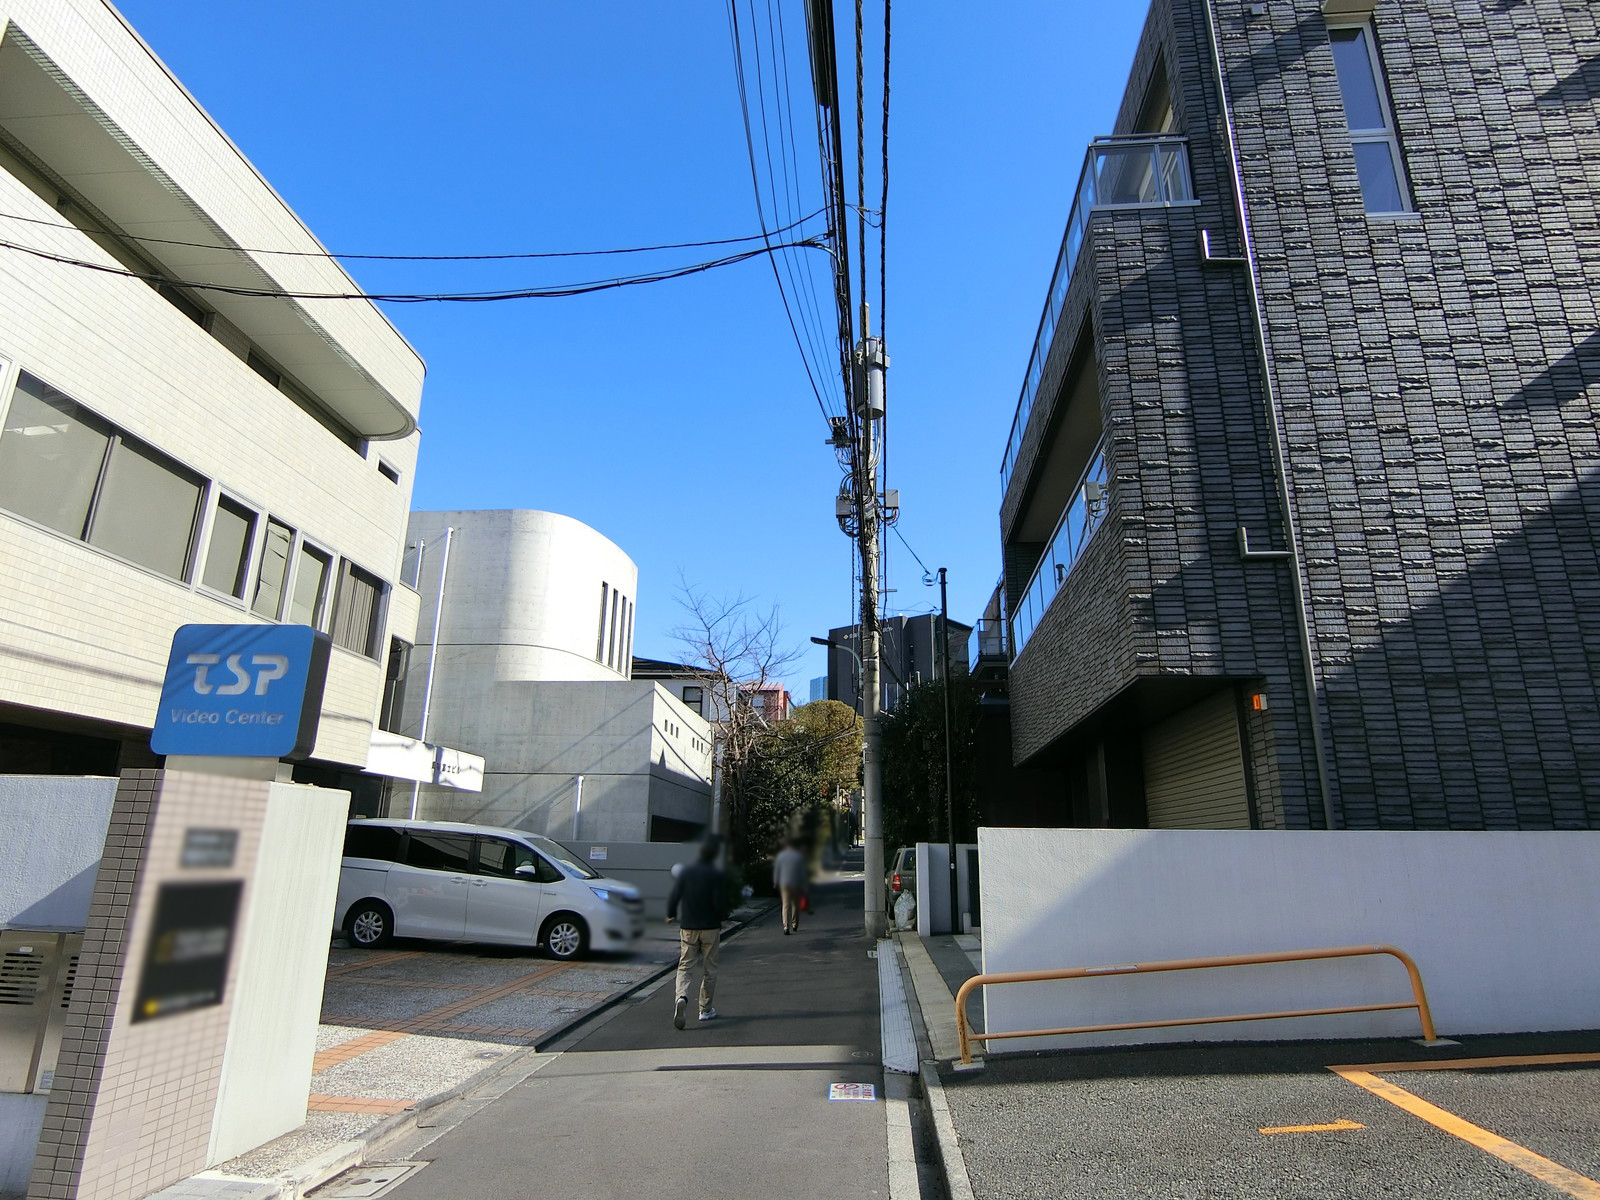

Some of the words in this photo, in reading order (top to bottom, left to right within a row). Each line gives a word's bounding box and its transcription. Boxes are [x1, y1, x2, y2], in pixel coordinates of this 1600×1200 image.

[186, 654, 289, 696] TSP
[171, 708, 220, 724] Video
[226, 709, 285, 725] Center
